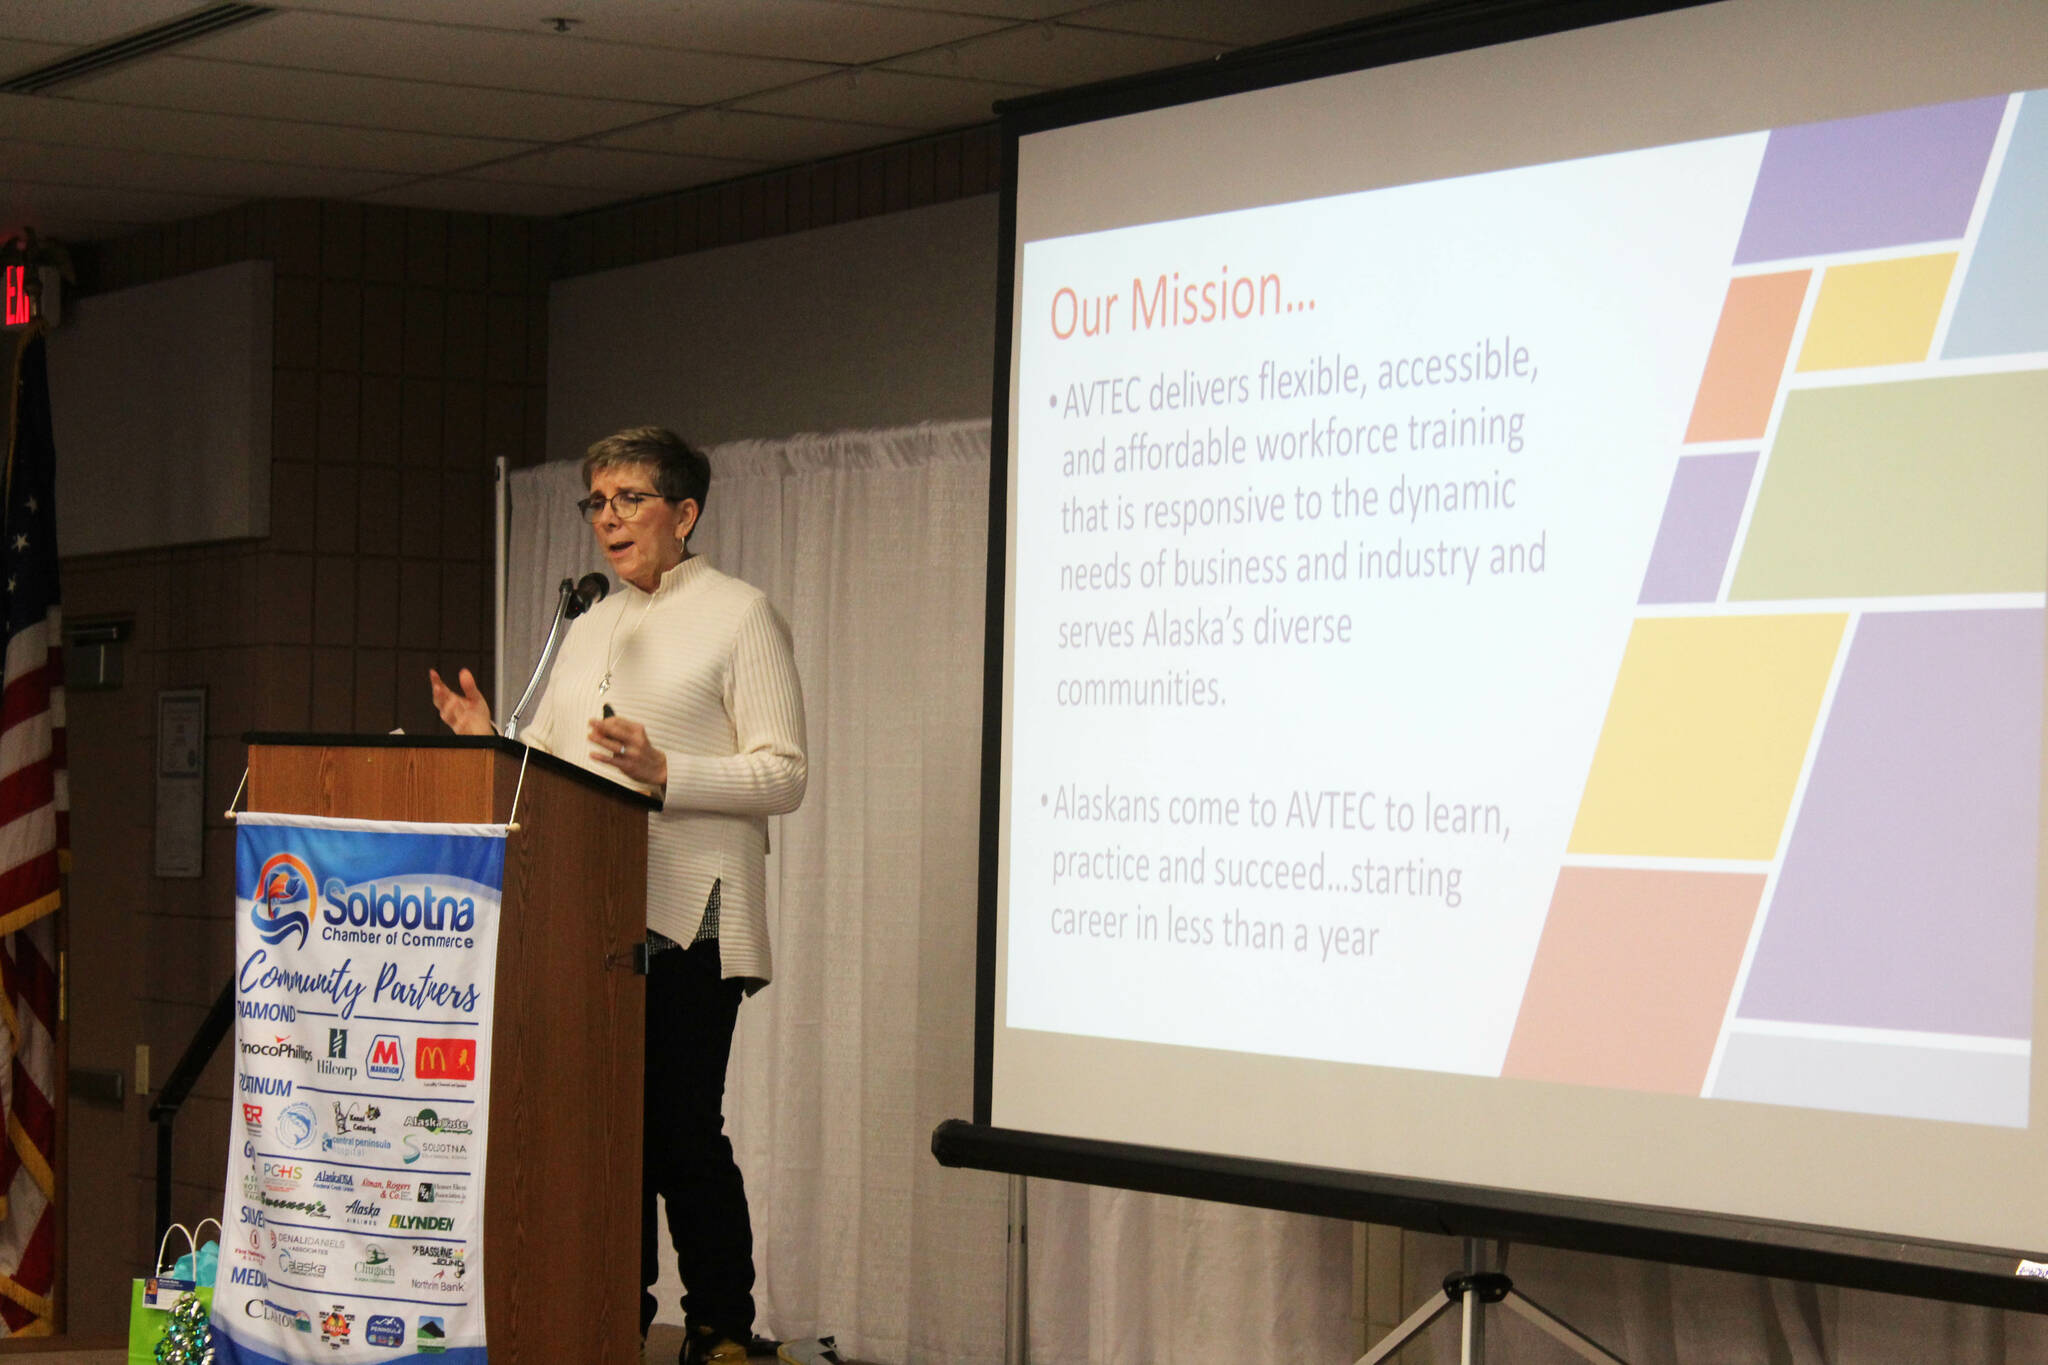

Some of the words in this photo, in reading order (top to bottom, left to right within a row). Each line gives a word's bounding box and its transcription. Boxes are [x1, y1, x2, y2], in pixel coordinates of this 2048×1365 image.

[1050, 287, 1119, 341] Our
[1131, 264, 1316, 332] Mission...
[1063, 375, 1142, 420] AVTEC
[1148, 369, 1250, 412] delivers
[1257, 354, 1367, 401] flexible,
[1377, 335, 1539, 391] accessible,
[1062, 435, 1106, 479] and
[1113, 424, 1247, 474] affordable
[1255, 415, 1399, 463] workforce
[1407, 405, 1526, 454] training
[1060, 495, 1110, 535] that
[1116, 494, 1136, 531] is
[1143, 485, 1286, 537] responsive
[1293, 485, 1323, 521] to
[1331, 476, 1379, 519] the
[1388, 469, 1517, 525] dynamic
[1060, 550, 1132, 592] needs
[1139, 547, 1168, 589] of
[1173, 545, 1288, 588] business
[1296, 539, 1348, 583] and
[1357, 536, 1481, 586] industry
[1489, 529, 1548, 576] and
[1057, 618, 1135, 650] serves
[1253, 604, 1353, 646] diverse
[1056, 669, 1226, 707] communities.
[1052, 782, 1160, 825] Alaskans
[1168, 794, 1241, 827] come
[1248, 792, 1277, 829] to
[1284, 789, 1377, 832] AVTEC
[1384, 795, 1415, 833] to
[1424, 790, 1511, 844] learn,
[1052, 843, 1150, 887] practice
[1158, 845, 1206, 886] and
[322, 877, 475, 933] Soldotna
[321, 926, 382, 946] Chamber
[385, 930, 398, 946] of
[401, 931, 475, 949] Commerce
[1050, 906, 1129, 939] career
[1135, 903, 1159, 942] in
[1167, 903, 1215, 947] less
[1221, 907, 1284, 951] than
[1292, 922, 1309, 954] a
[1317, 923, 1382, 964] year
[239, 949, 368, 1021] Community
[372, 961, 481, 1013] Partners
[316, 1059, 358, 1081] Hilcorp
[369, 1065, 400, 1075] MARATHON
[355, 1137, 392, 1150] peninsula
[263, 1163, 304, 1180] PCHS
[345, 1200, 381, 1218] Alaska
[354, 1262, 396, 1278] Chugach
[440, 1281, 465, 1293] Bank
